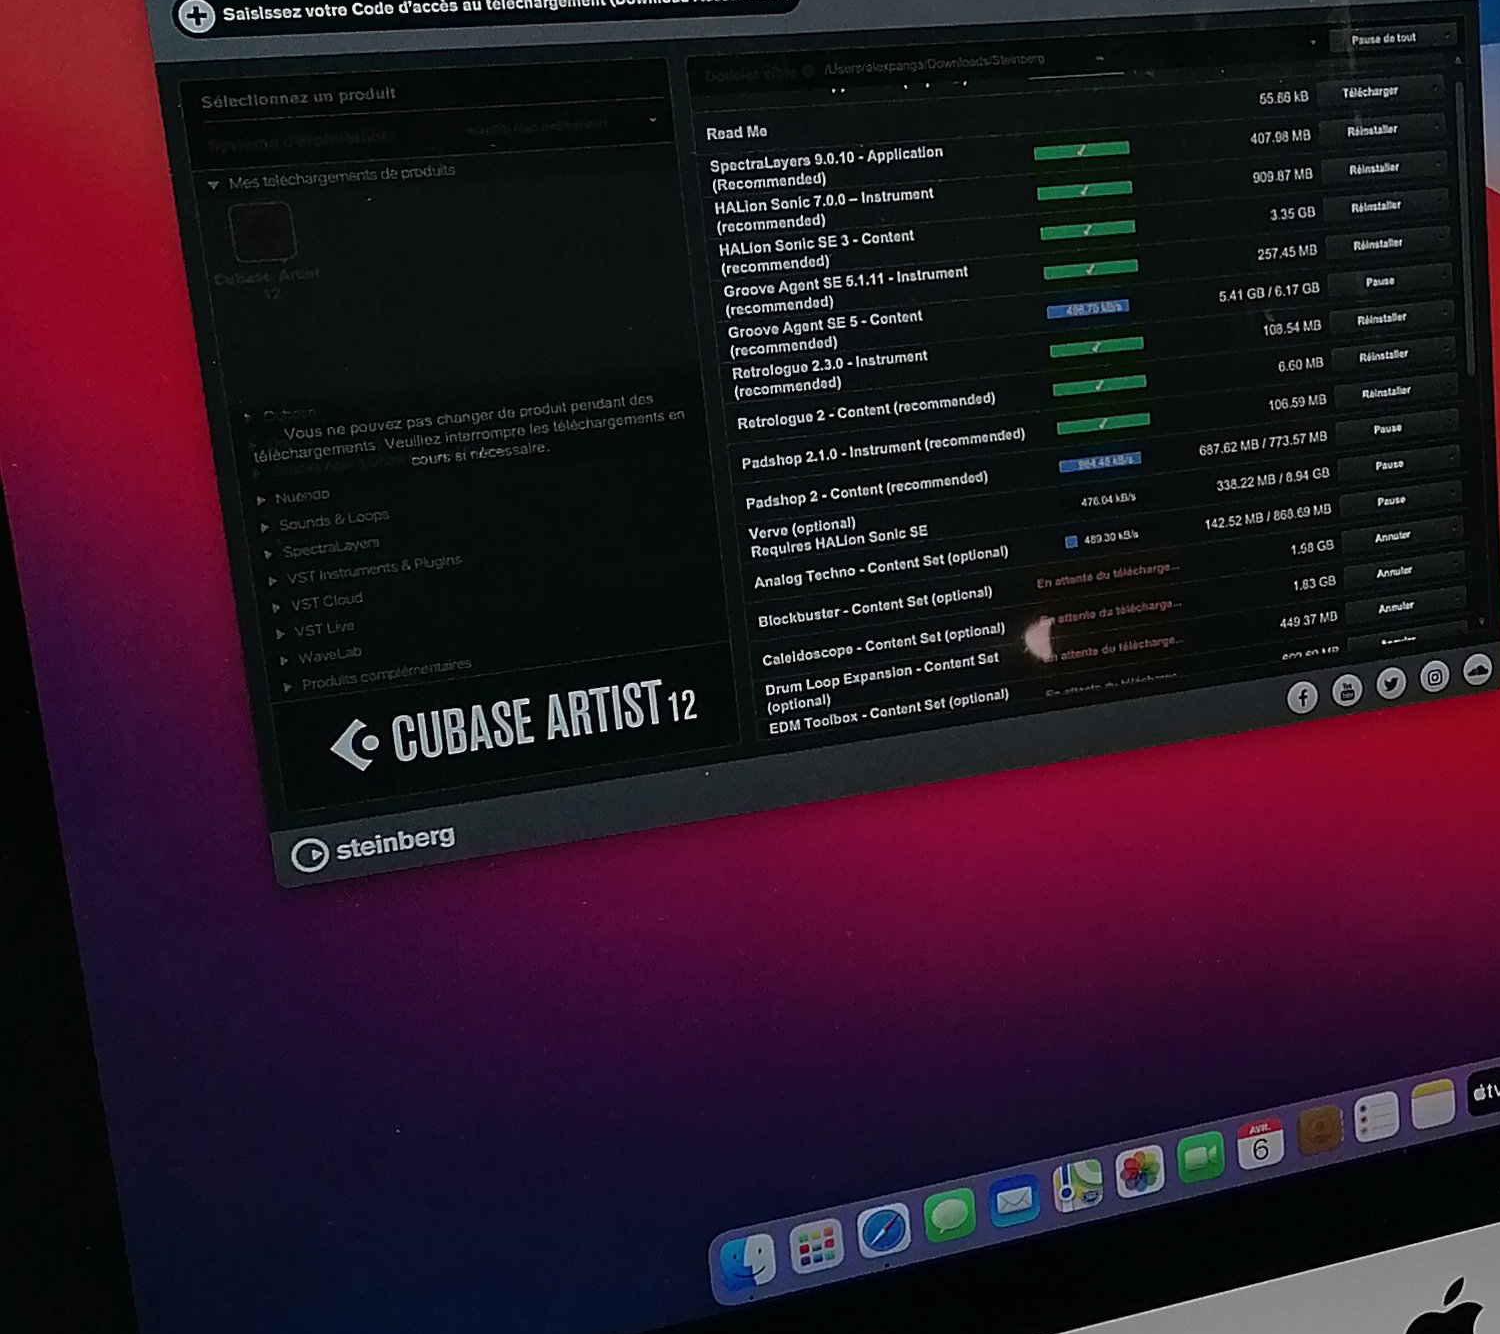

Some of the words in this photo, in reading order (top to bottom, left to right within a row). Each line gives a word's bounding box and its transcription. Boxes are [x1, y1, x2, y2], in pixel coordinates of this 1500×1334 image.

[223, 7, 302, 22] Saisissez
[304, 3, 348, 18] votre
[352, 1, 394, 16] Code
[398, 0, 460, 14] d'accès
[462, 1, 482, 12] au
[1352, 35, 1381, 46] Pause
[1383, 34, 1396, 44] de
[1397, 32, 1417, 43] tout
[706, 127, 743, 141] Read
[746, 125, 768, 138] Me
[710, 153, 811, 174] SpectraLayers
[814, 151, 855, 166] 9.0.10
[866, 146, 944, 164] Application
[712, 171, 827, 195] (Recommended)
[715, 200, 768, 215] HALion
[770, 196, 811, 211] Sonic
[814, 193, 846, 208] 7.0.0
[861, 187, 935, 205] Instrument
[719, 241, 772, 257] HALion
[775, 237, 816, 252] Sonic
[818, 235, 838, 249] SE
[841, 234, 850, 247] 3
[862, 229, 915, 245] Content
[724, 283, 776, 298] Groove
[778, 279, 820, 295] Agent
[823, 277, 842, 289] SE
[846, 273, 884, 287] 5.1.11
[896, 265, 970, 283] Instrument
[392, 697, 535, 762] CUBASE
[547, 679, 663, 741] ARTIST
[668, 689, 698, 722] 12
[336, 827, 456, 861] steinberg
[1253, 1138, 1268, 1161] 6
